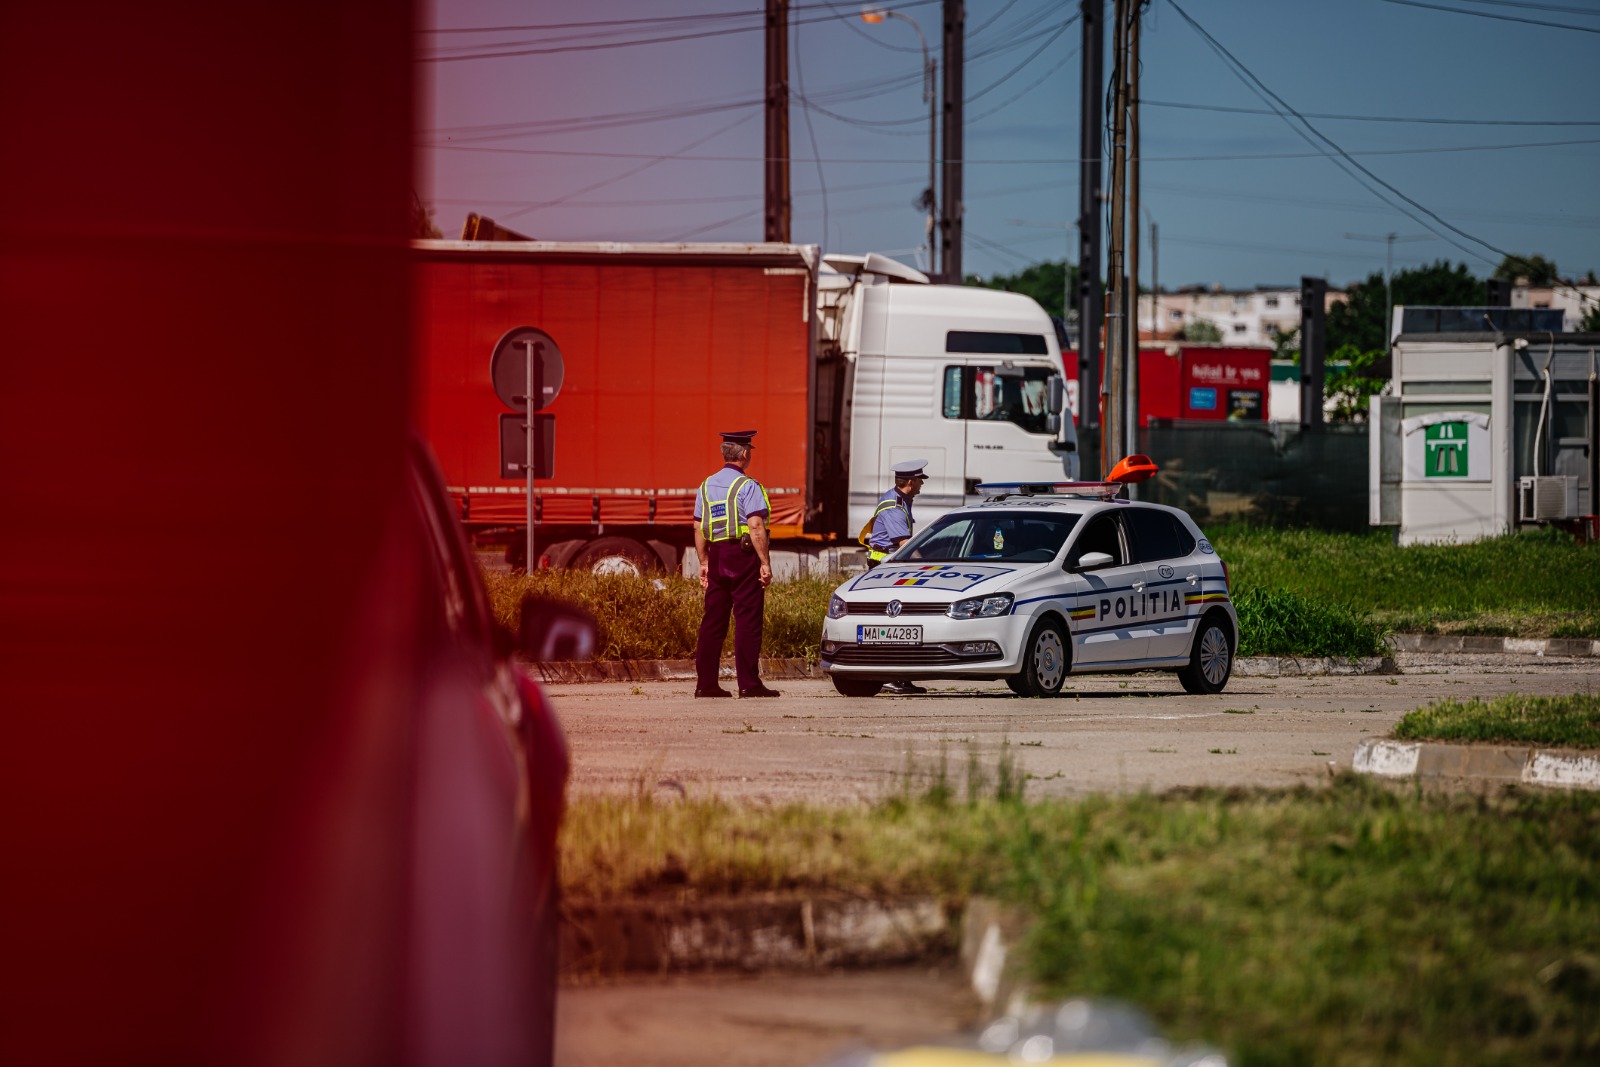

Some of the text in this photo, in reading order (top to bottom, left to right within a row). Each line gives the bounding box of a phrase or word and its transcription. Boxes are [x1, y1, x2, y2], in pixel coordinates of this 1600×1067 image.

[1100, 589, 1181, 621] POLITIA
[864, 627, 880, 640] MAI
[886, 627, 919, 640] 44283
